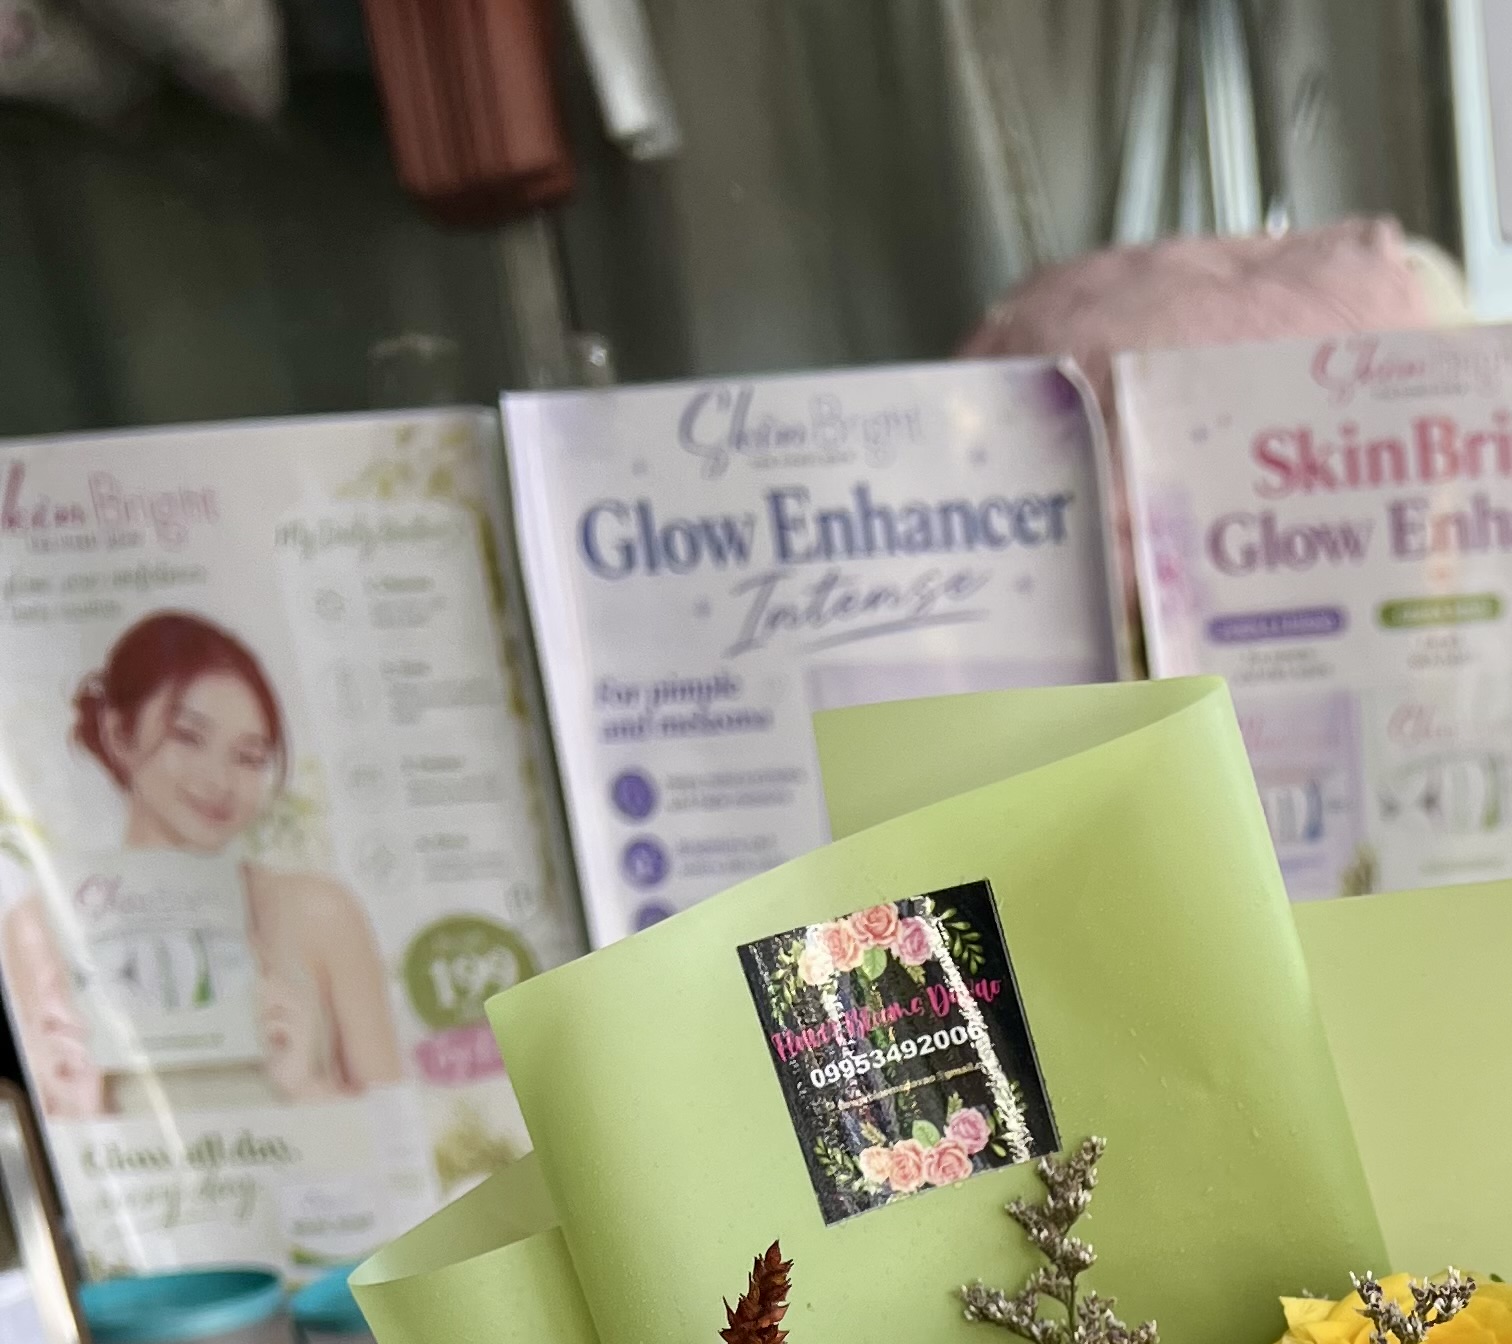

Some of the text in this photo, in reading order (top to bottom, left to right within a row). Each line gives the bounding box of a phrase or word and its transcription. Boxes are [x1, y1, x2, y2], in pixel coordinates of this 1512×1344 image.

[578, 482, 1075, 582] Glow Enhancer
[1206, 508, 1378, 577] Glow
[722, 565, 990, 660] Intense
